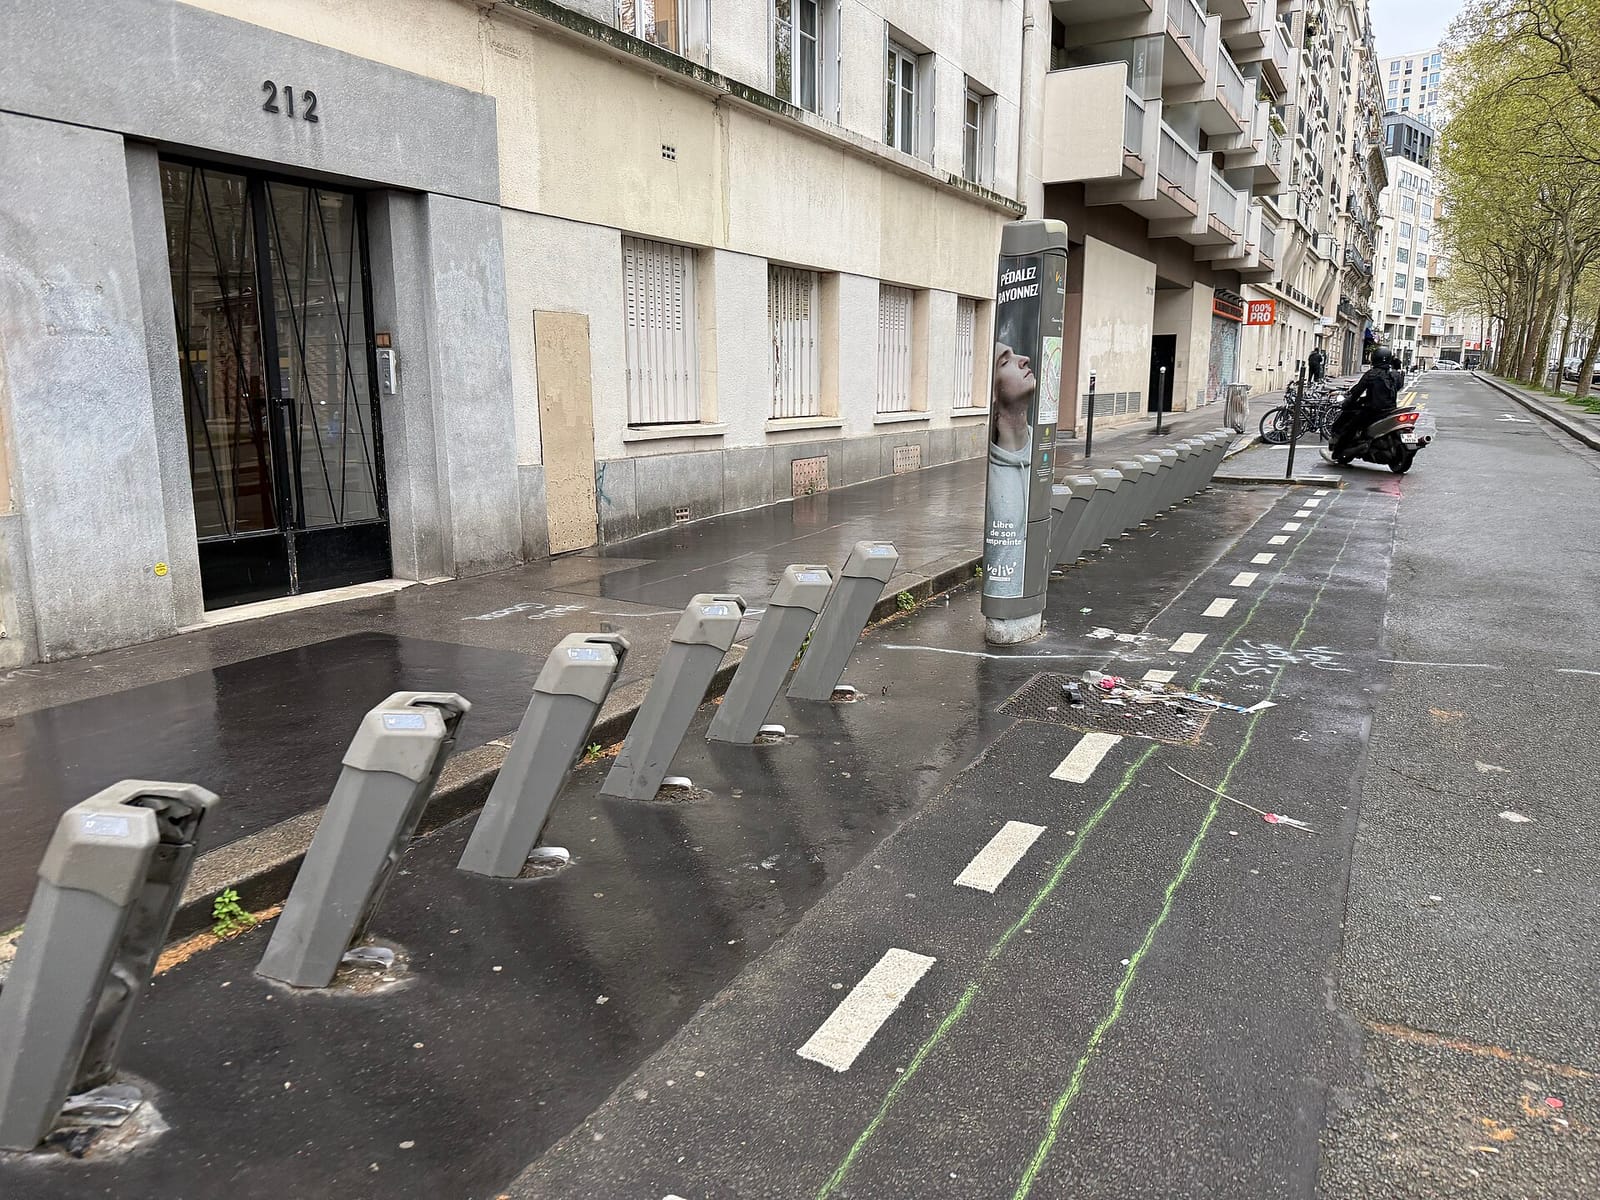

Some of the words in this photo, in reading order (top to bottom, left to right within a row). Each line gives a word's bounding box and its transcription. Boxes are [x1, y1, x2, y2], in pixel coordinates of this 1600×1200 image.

[262, 79, 319, 123] 212
[1000, 266, 1036, 287] PÉDALEZ
[1251, 303, 1271, 312] 100%
[1250, 312, 1270, 322] PRO
[993, 520, 1014, 529] Libre
[990, 529, 999, 537] de
